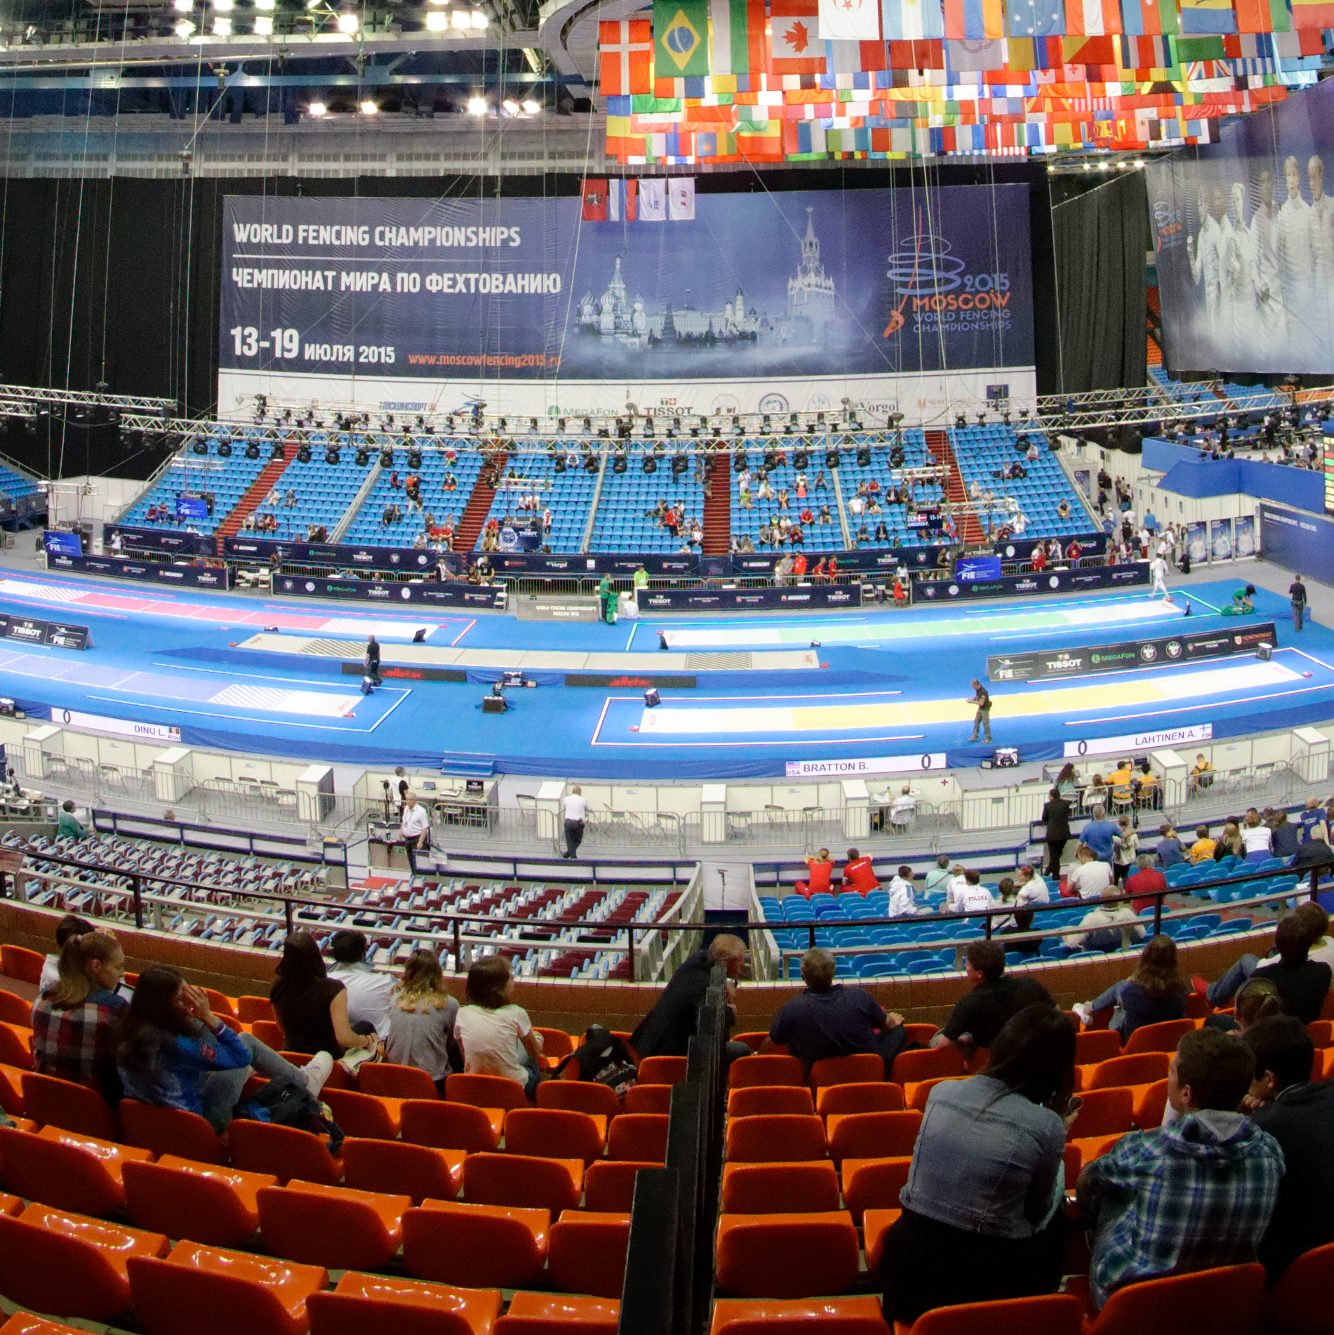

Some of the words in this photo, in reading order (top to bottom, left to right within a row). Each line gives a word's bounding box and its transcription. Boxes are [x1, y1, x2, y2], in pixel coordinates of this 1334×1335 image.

[233, 223, 294, 244] WORLD
[298, 225, 370, 246] FENCING
[374, 226, 521, 247] CHAMPIONSHIPS
[232, 268, 336, 291] ЧЕМПИОНАТ
[341, 271, 391, 292] МИРА
[396, 272, 421, 292] ПО
[425, 272, 561, 294] ФЕХТОВАНИЮ
[964, 273, 1011, 292] 2015
[912, 292, 1011, 311] MOSCOW
[913, 313, 956, 323] WORLD
[960, 309, 1011, 320] FENCING
[913, 320, 1012, 333] CHAMPIONSHIPS
[230, 326, 299, 359] 13-19
[304, 343, 355, 362] ИЮЛЯ
[359, 345, 396, 363] 2015
[408, 353, 562, 368] www.moscowfencing2015.ru
[644, 407, 694, 416] TISSOT
[50, 544, 61, 552] FIE
[962, 571, 976, 580] FIE
[13, 625, 42, 637] TISSOT
[53, 635, 65, 645] FIE
[1046, 659, 1082, 669] TISSOT
[1101, 652, 1135, 662] MEGAFON
[999, 669, 1014, 678] FIE
[63, 709, 71, 724] 0
[134, 725, 156, 735] DINU
[158, 728, 166, 736] L.
[1077, 740, 1087, 755] 0
[1135, 731, 1185, 746] LAHTINEN
[1187, 729, 1197, 738] A.
[803, 763, 856, 773] BRATTON
[858, 762, 869, 770] B.
[921, 753, 932, 770] 0
